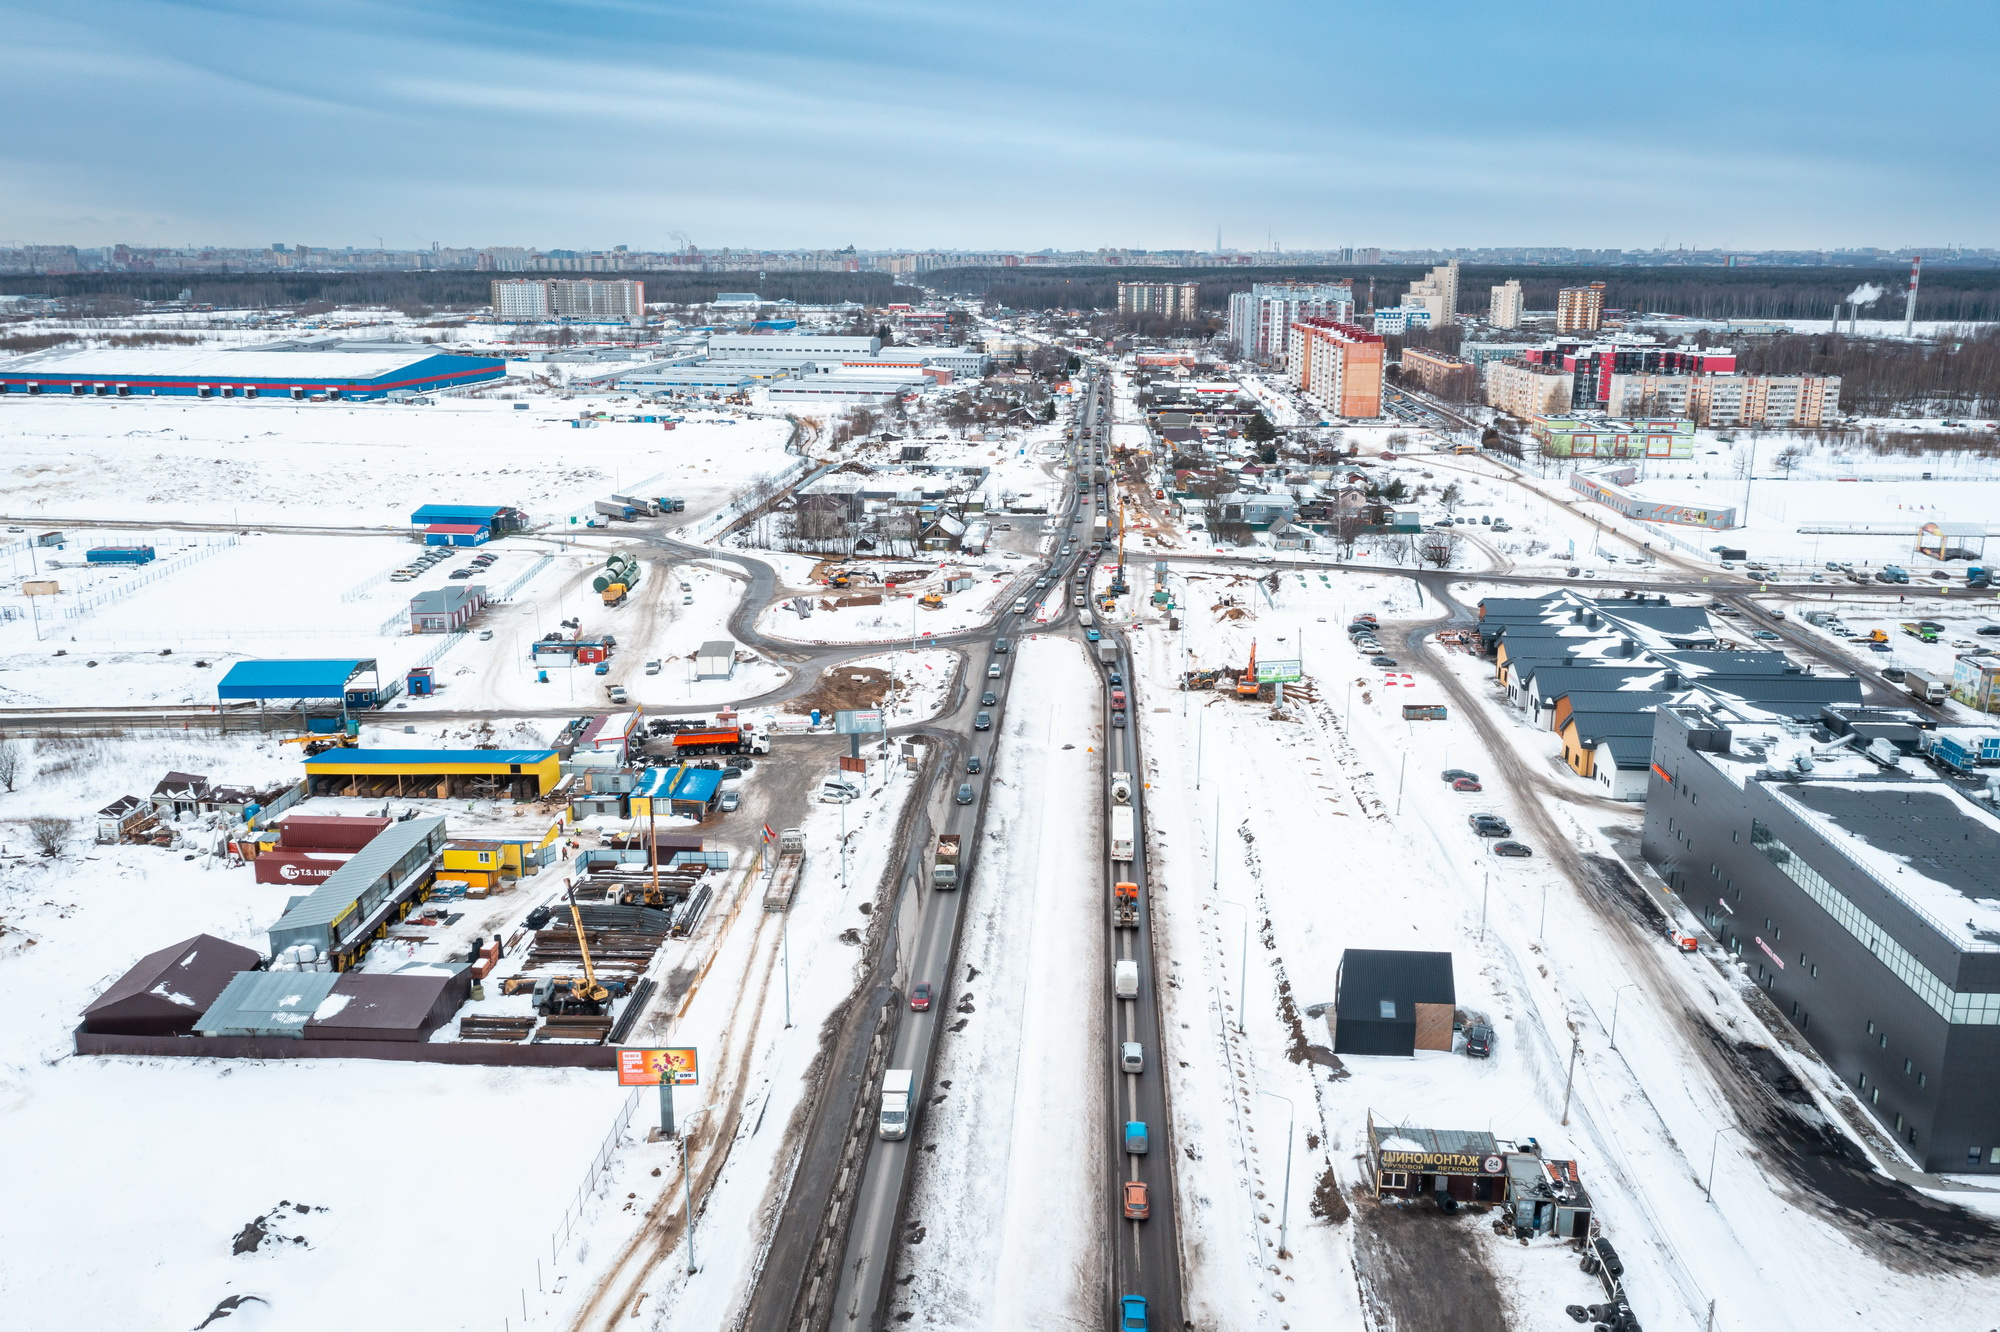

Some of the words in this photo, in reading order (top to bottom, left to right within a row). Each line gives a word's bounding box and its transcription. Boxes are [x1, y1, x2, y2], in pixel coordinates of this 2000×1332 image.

[300, 868, 313, 876] T.S.
[1383, 1151, 1480, 1167] ШИНОМОНТАЖ
[1488, 1160, 1499, 1168] 24
[1437, 1165, 1480, 1173] ЛЕГКОВОЙ
